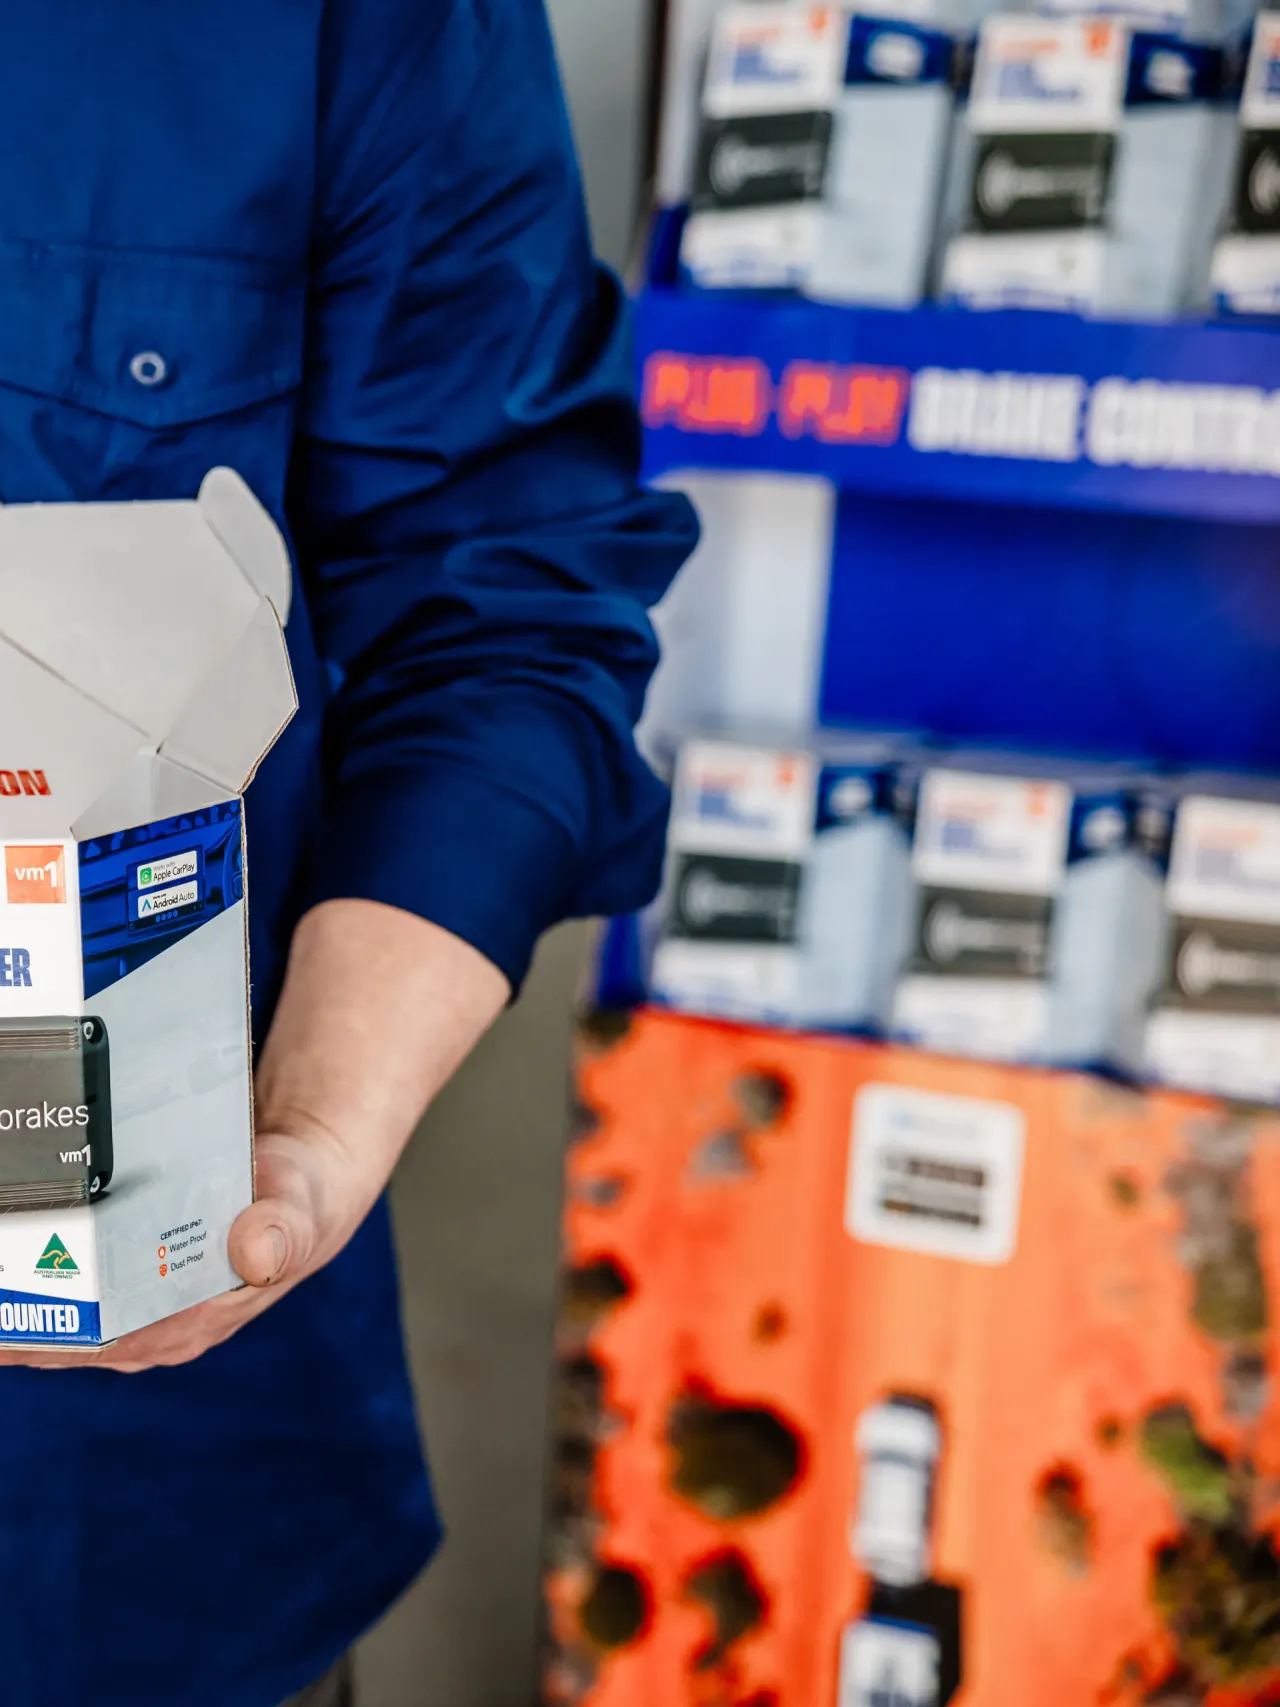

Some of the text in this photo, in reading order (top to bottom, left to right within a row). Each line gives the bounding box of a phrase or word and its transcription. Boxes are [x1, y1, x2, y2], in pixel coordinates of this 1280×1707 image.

[14, 861, 57, 888] vm1
[153, 863, 195, 882] Apple CarPlay
[153, 891, 195, 910] Android Auto
[60, 1144, 91, 1166] vm1
[160, 1224, 190, 1240] CERTIFIED
[169, 1230, 207, 1253] Water Proof
[170, 1250, 204, 1271] Dust Proof
